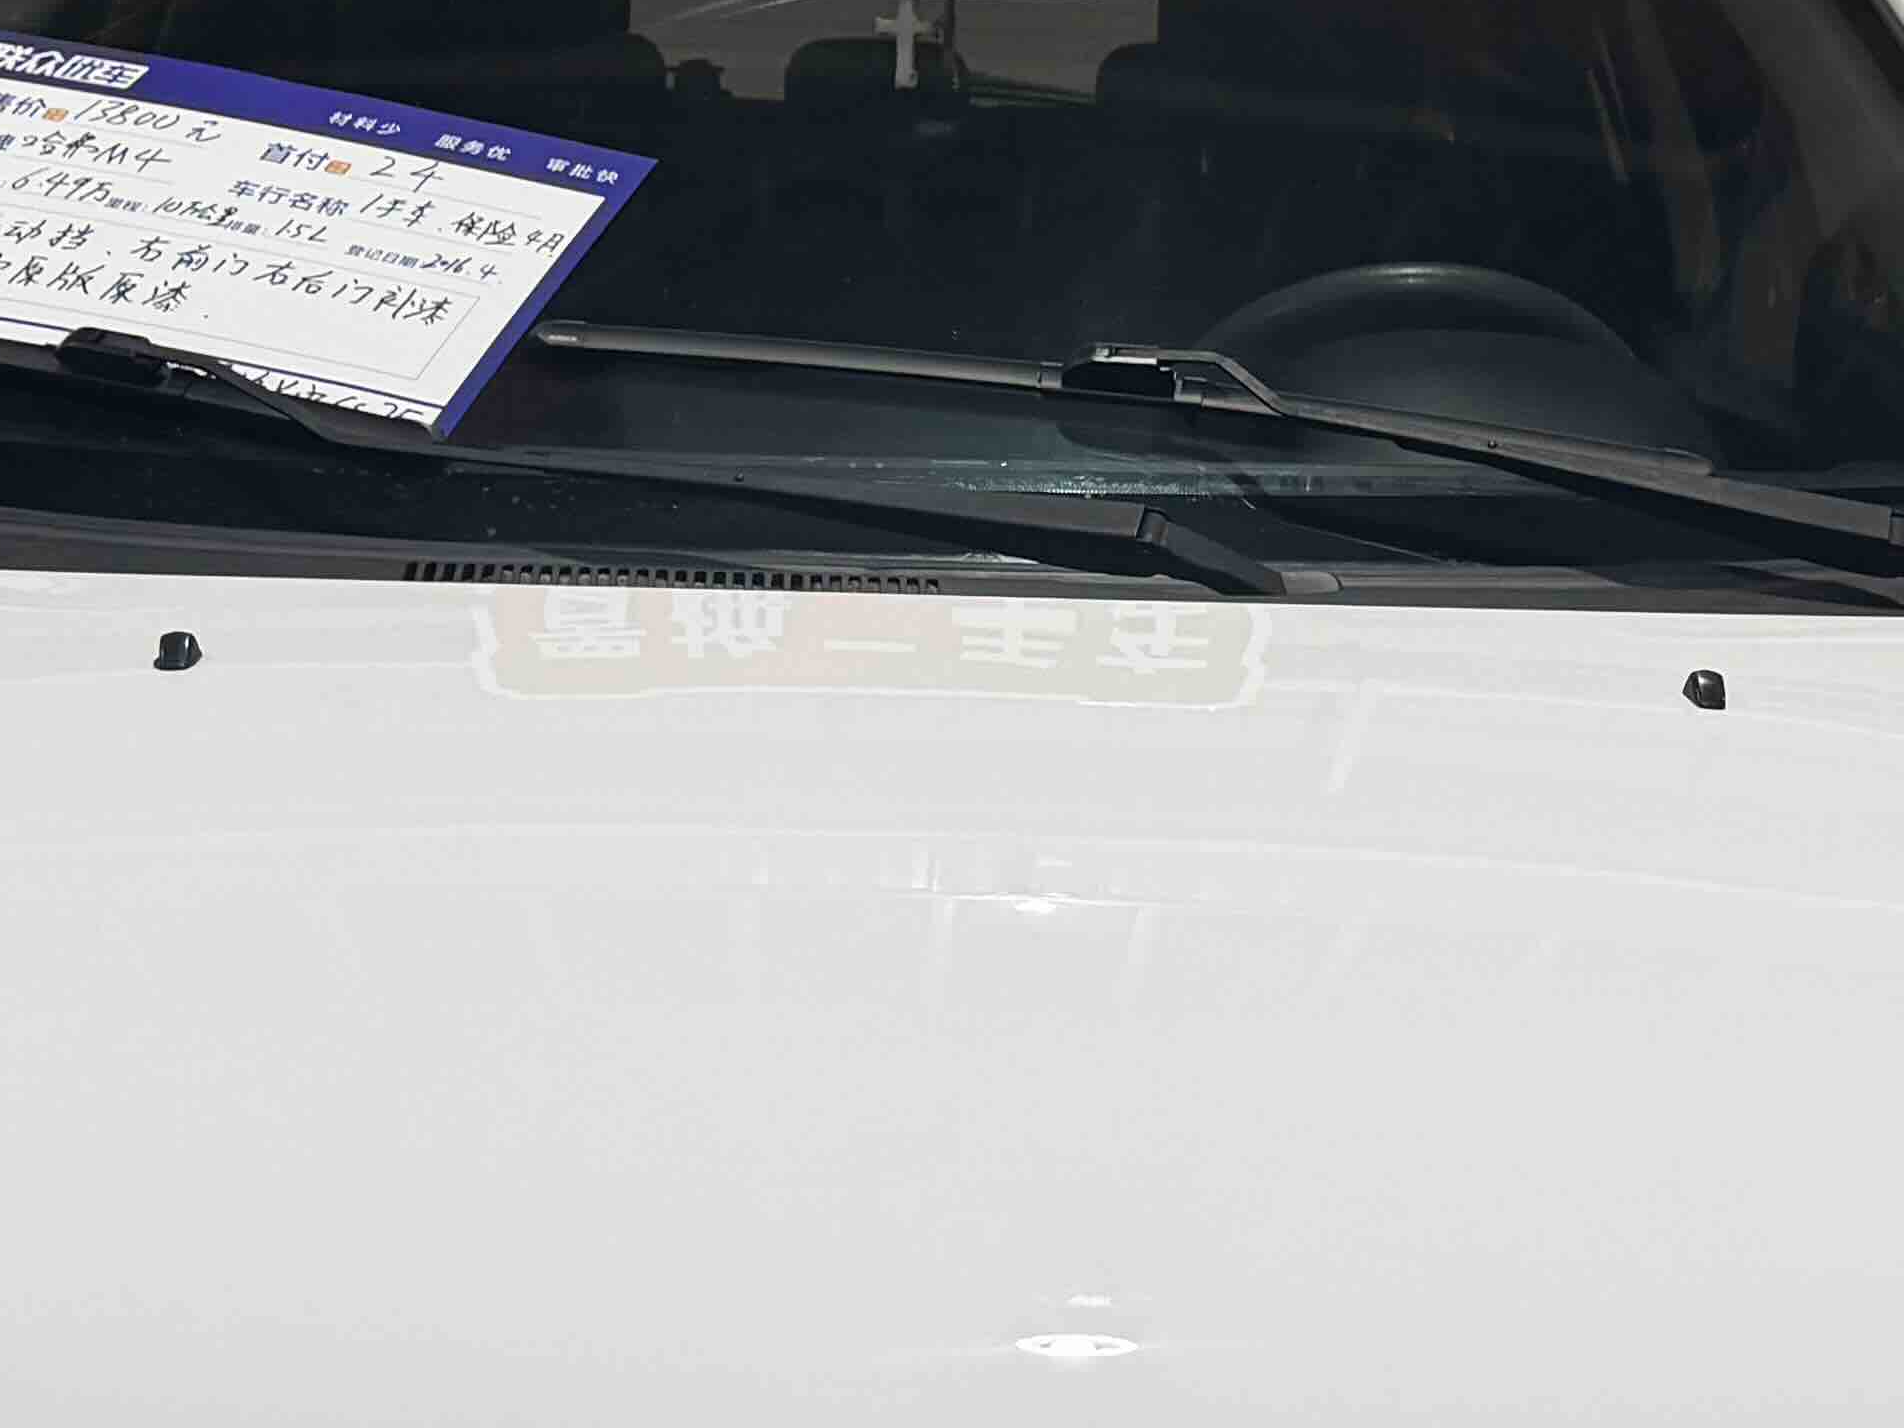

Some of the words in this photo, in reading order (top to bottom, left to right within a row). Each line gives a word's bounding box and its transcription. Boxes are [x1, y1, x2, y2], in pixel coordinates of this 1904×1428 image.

[259, 142, 328, 172] 首付
[329, 110, 401, 136] 材料少
[436, 134, 512, 162] 服务优
[546, 156, 618, 186] 审批快
[228, 179, 350, 219] 车行名称
